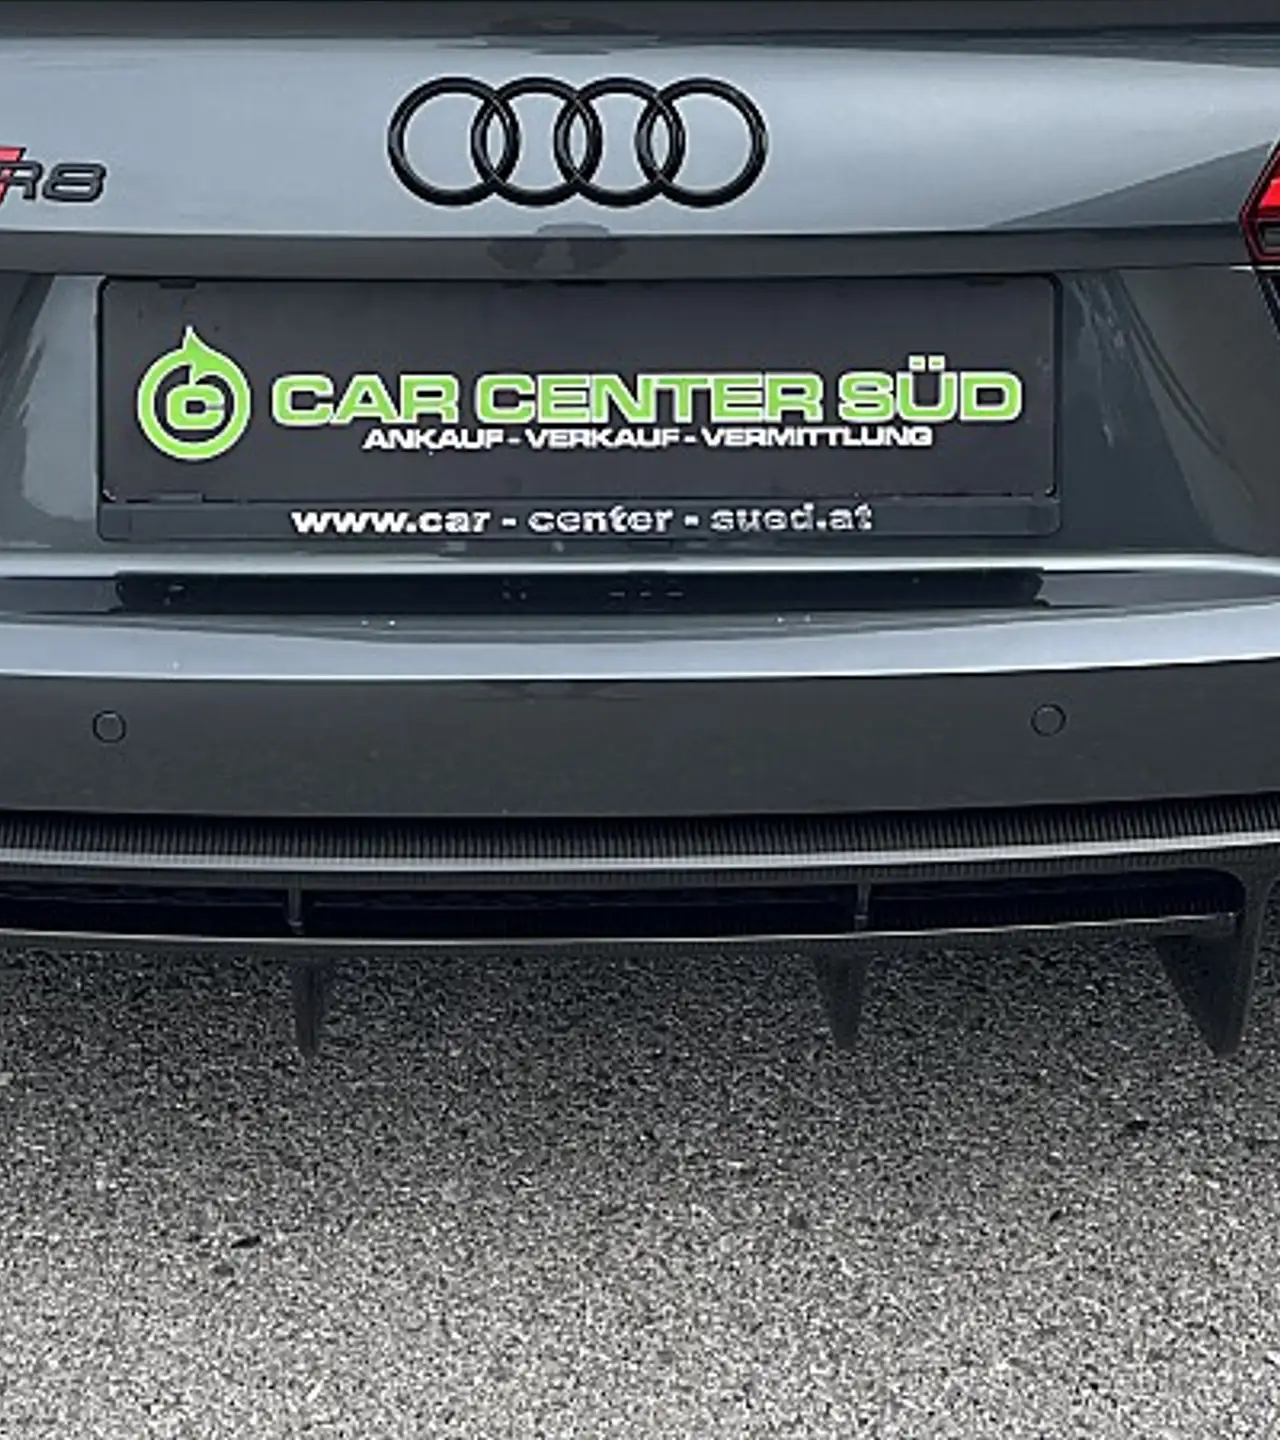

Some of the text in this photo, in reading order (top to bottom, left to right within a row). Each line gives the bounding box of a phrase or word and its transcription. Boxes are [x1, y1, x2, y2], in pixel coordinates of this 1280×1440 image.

[271, 354, 1023, 427] CAR CENTER SÜD
